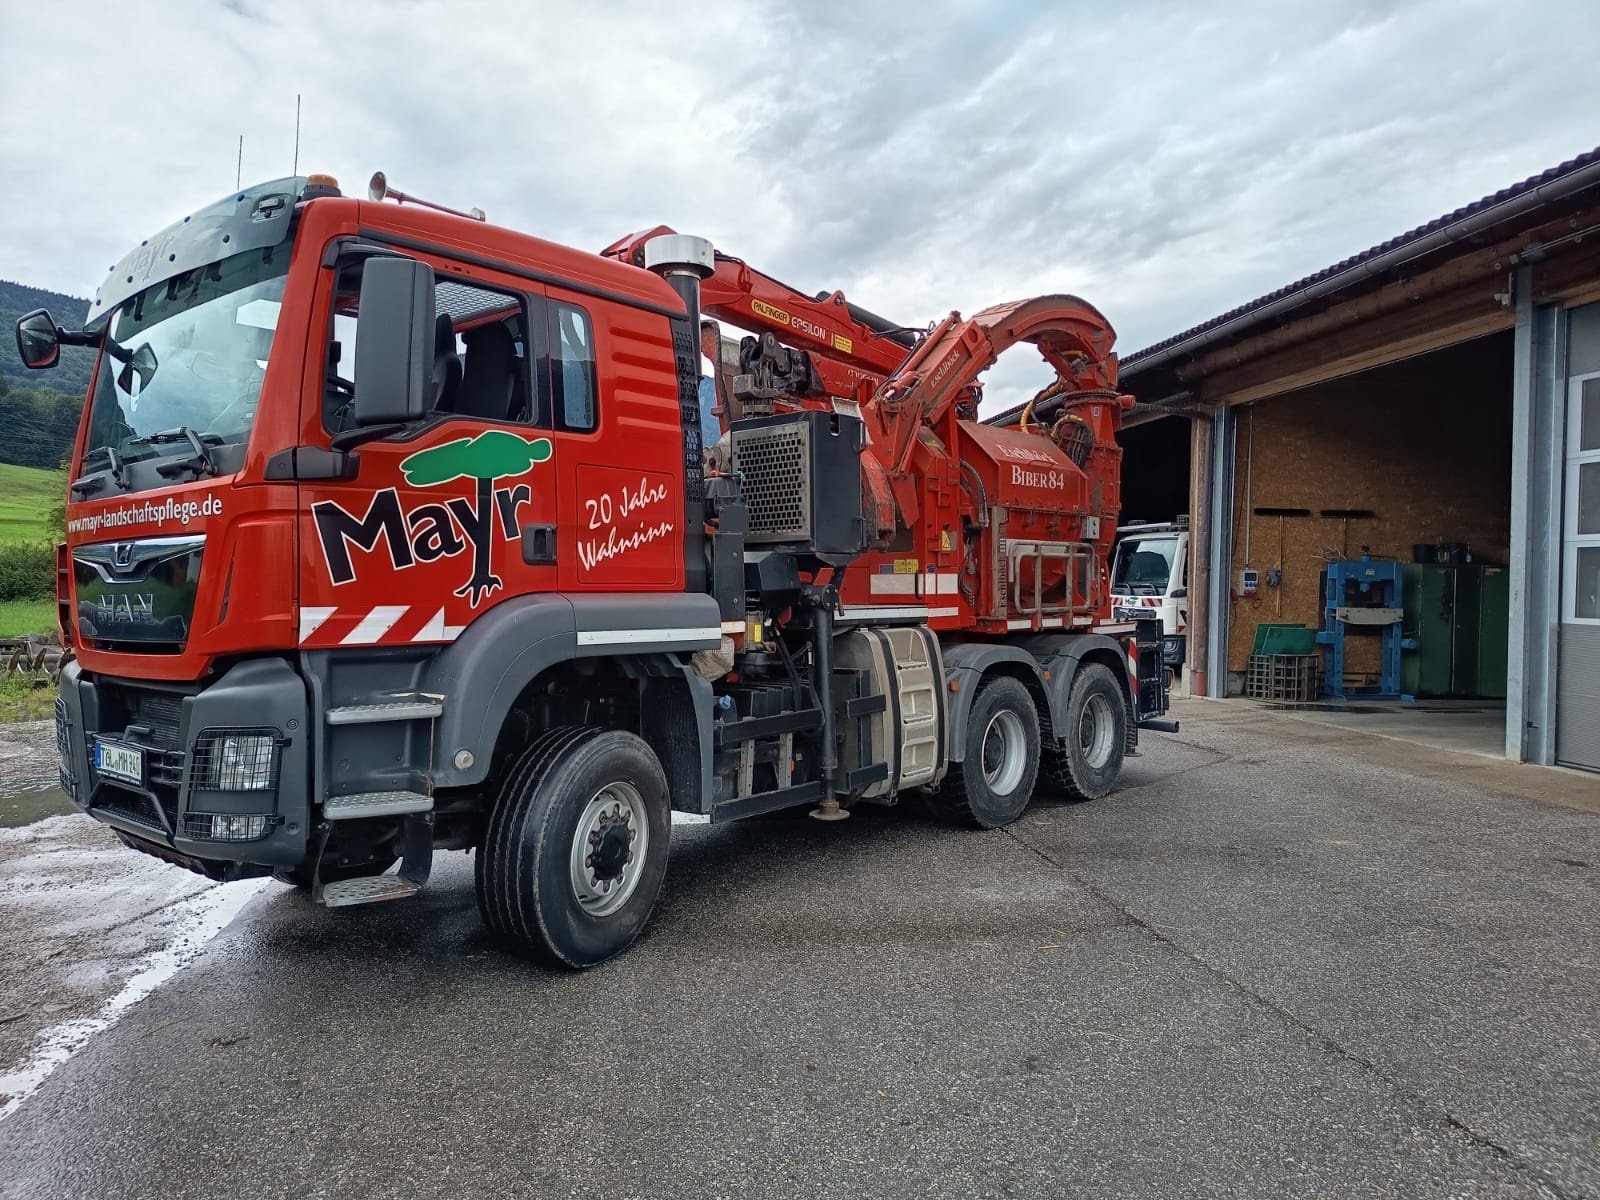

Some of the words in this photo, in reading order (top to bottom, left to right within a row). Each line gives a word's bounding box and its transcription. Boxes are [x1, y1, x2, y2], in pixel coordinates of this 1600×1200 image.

[753, 301, 788, 321] PALFINGER
[791, 316, 826, 340] EPSILON
[68, 493, 223, 535] www.mayr-landschaftspflege.de
[585, 493, 612, 530] 20
[619, 477, 668, 518] Jahre
[311, 485, 532, 609] Mayr
[577, 521, 674, 572] Wahnsinn
[97, 593, 154, 623] MAN
